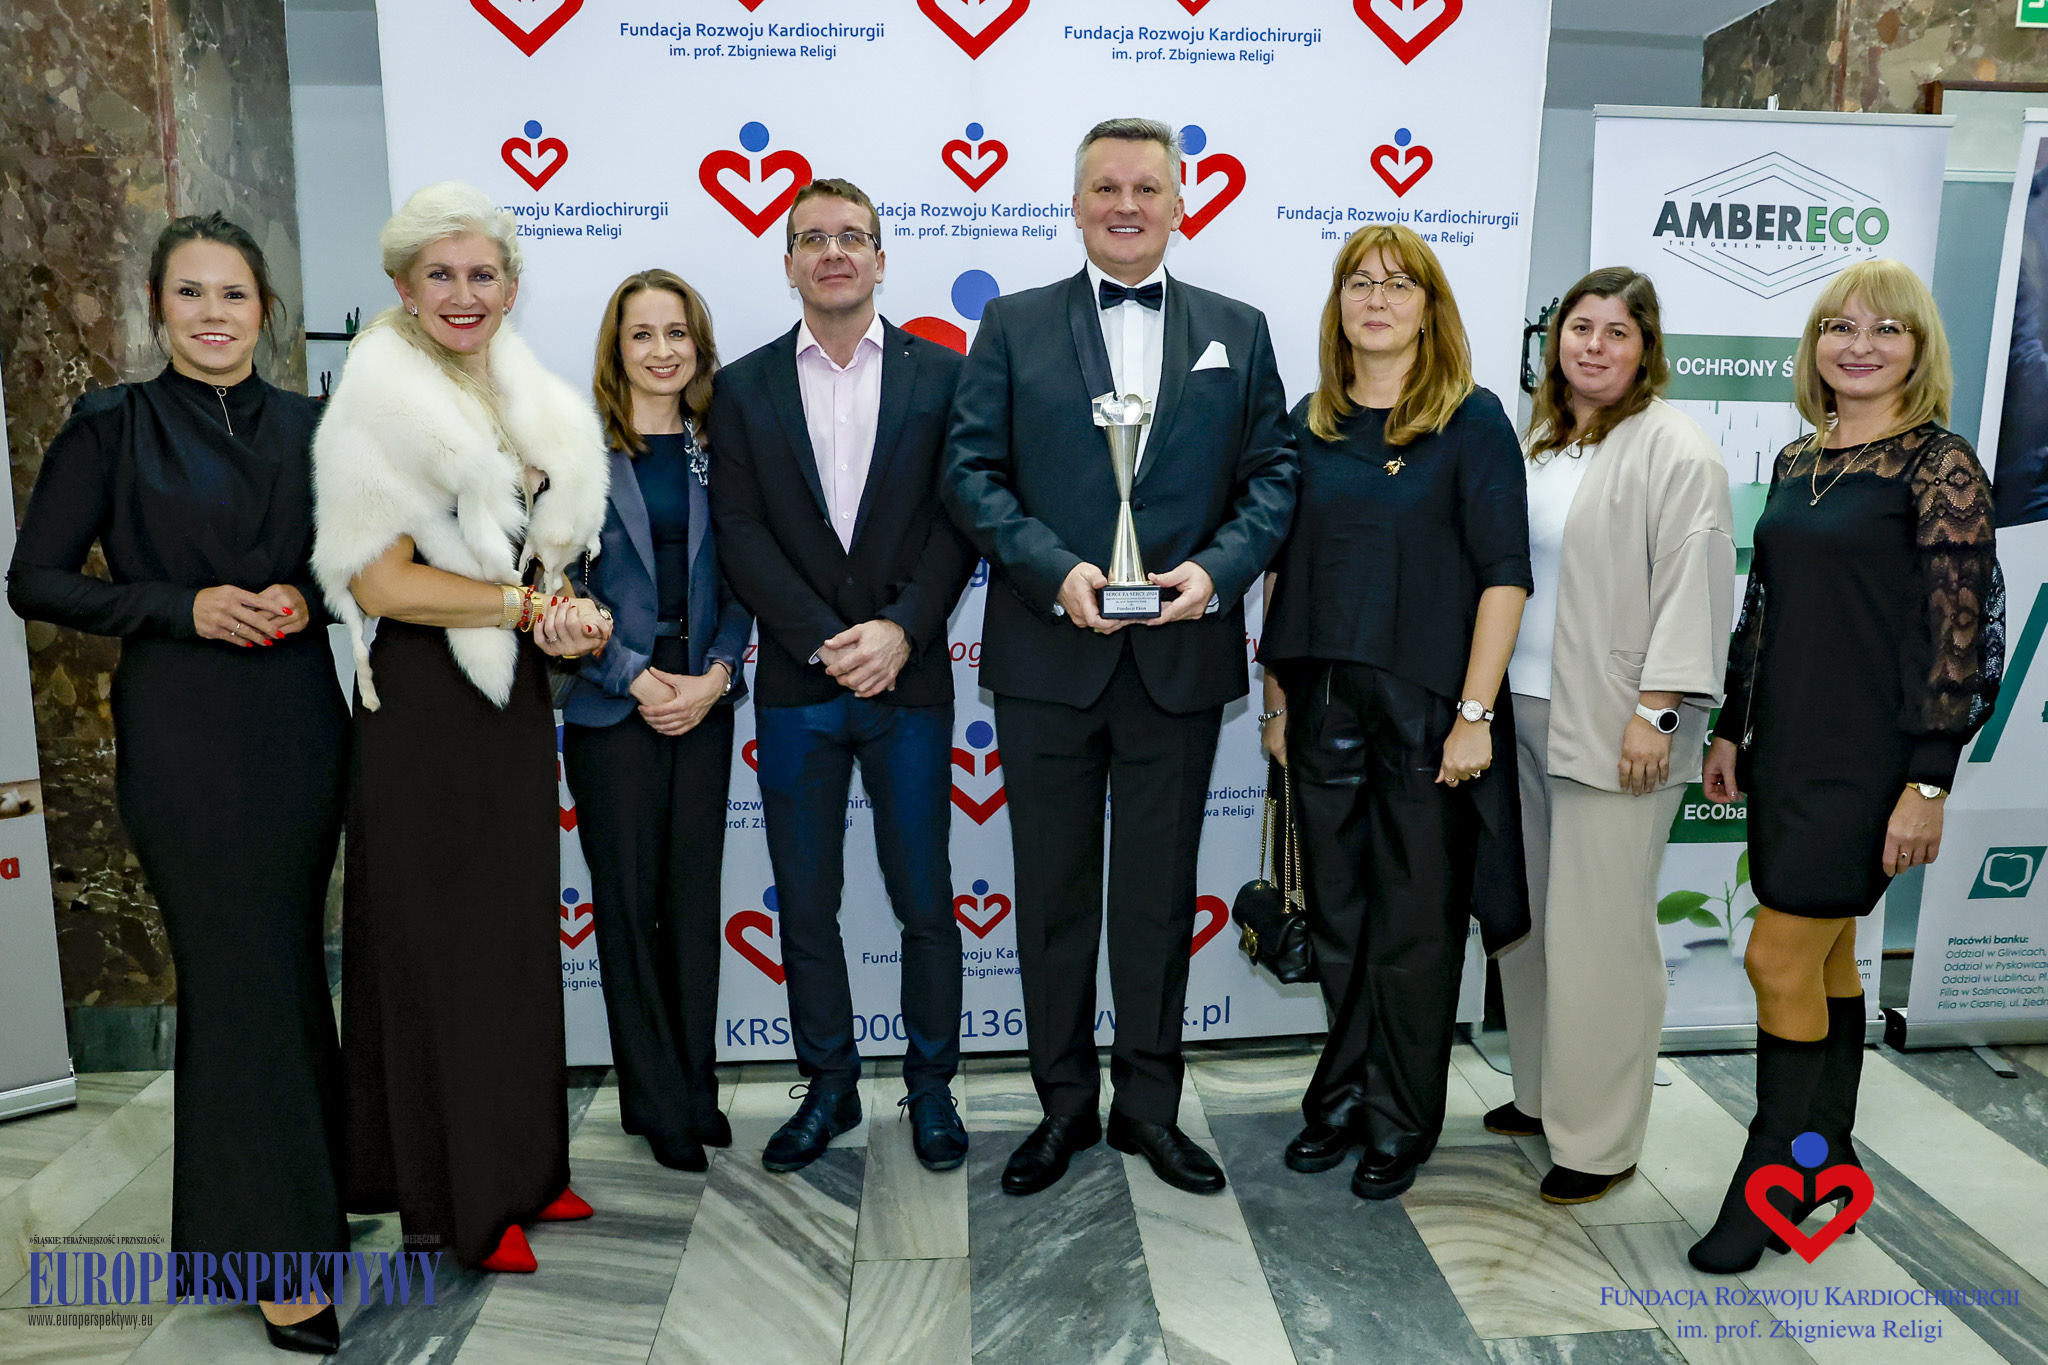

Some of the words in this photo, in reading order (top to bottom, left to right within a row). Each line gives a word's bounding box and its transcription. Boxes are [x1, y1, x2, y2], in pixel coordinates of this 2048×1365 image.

[620, 22, 691, 41] Fundacja
[696, 22, 764, 41] Rozwoju
[768, 23, 885, 42] Kardiochirurgii
[1064, 25, 1134, 44] Fundacja
[1138, 26, 1205, 45] Rozwoju
[1209, 27, 1322, 46] Kardiochirurgii
[669, 45, 691, 57] im.
[694, 45, 724, 60] prof.
[727, 45, 797, 61] Zbigniewa
[800, 45, 837, 61] Religi
[1112, 47, 1132, 60] im.
[1136, 48, 1166, 63] prof.
[1169, 48, 1236, 64] Zbigniewa
[1239, 49, 1275, 65] Religi
[554, 201, 669, 221] Kardiochirurgii
[877, 202, 916, 221] dacja
[921, 202, 987, 221] Rozwoju
[1277, 205, 1343, 224] Fundacja
[1347, 207, 1410, 224] Rozwoju
[1414, 209, 1519, 230] Kardiochirurgii
[1652, 200, 1890, 246] AMBERECO
[516, 224, 583, 240] Zbigniewa
[586, 224, 622, 240] Religi
[894, 224, 915, 237] im.
[918, 224, 948, 239] prof.
[952, 224, 1018, 240] Zbigniewa
[1022, 225, 1058, 241] Religi
[1321, 227, 1341, 240] im.
[1441, 231, 1474, 247] Religi
[1710, 242, 1762, 250] GREEN
[1777, 244, 1873, 253] SOLUTIONS
[1676, 357, 1778, 378] OCHRONY
[1222, 804, 1255, 819] Religi
[1948, 935, 1992, 946] Placówki
[1993, 934, 2029, 945] banku:
[1940, 988, 1959, 997] Filia
[1937, 1001, 1957, 1010] Filia
[2022, 998, 2048, 1008] Zjedn
[726, 1017, 790, 1047] KRS
